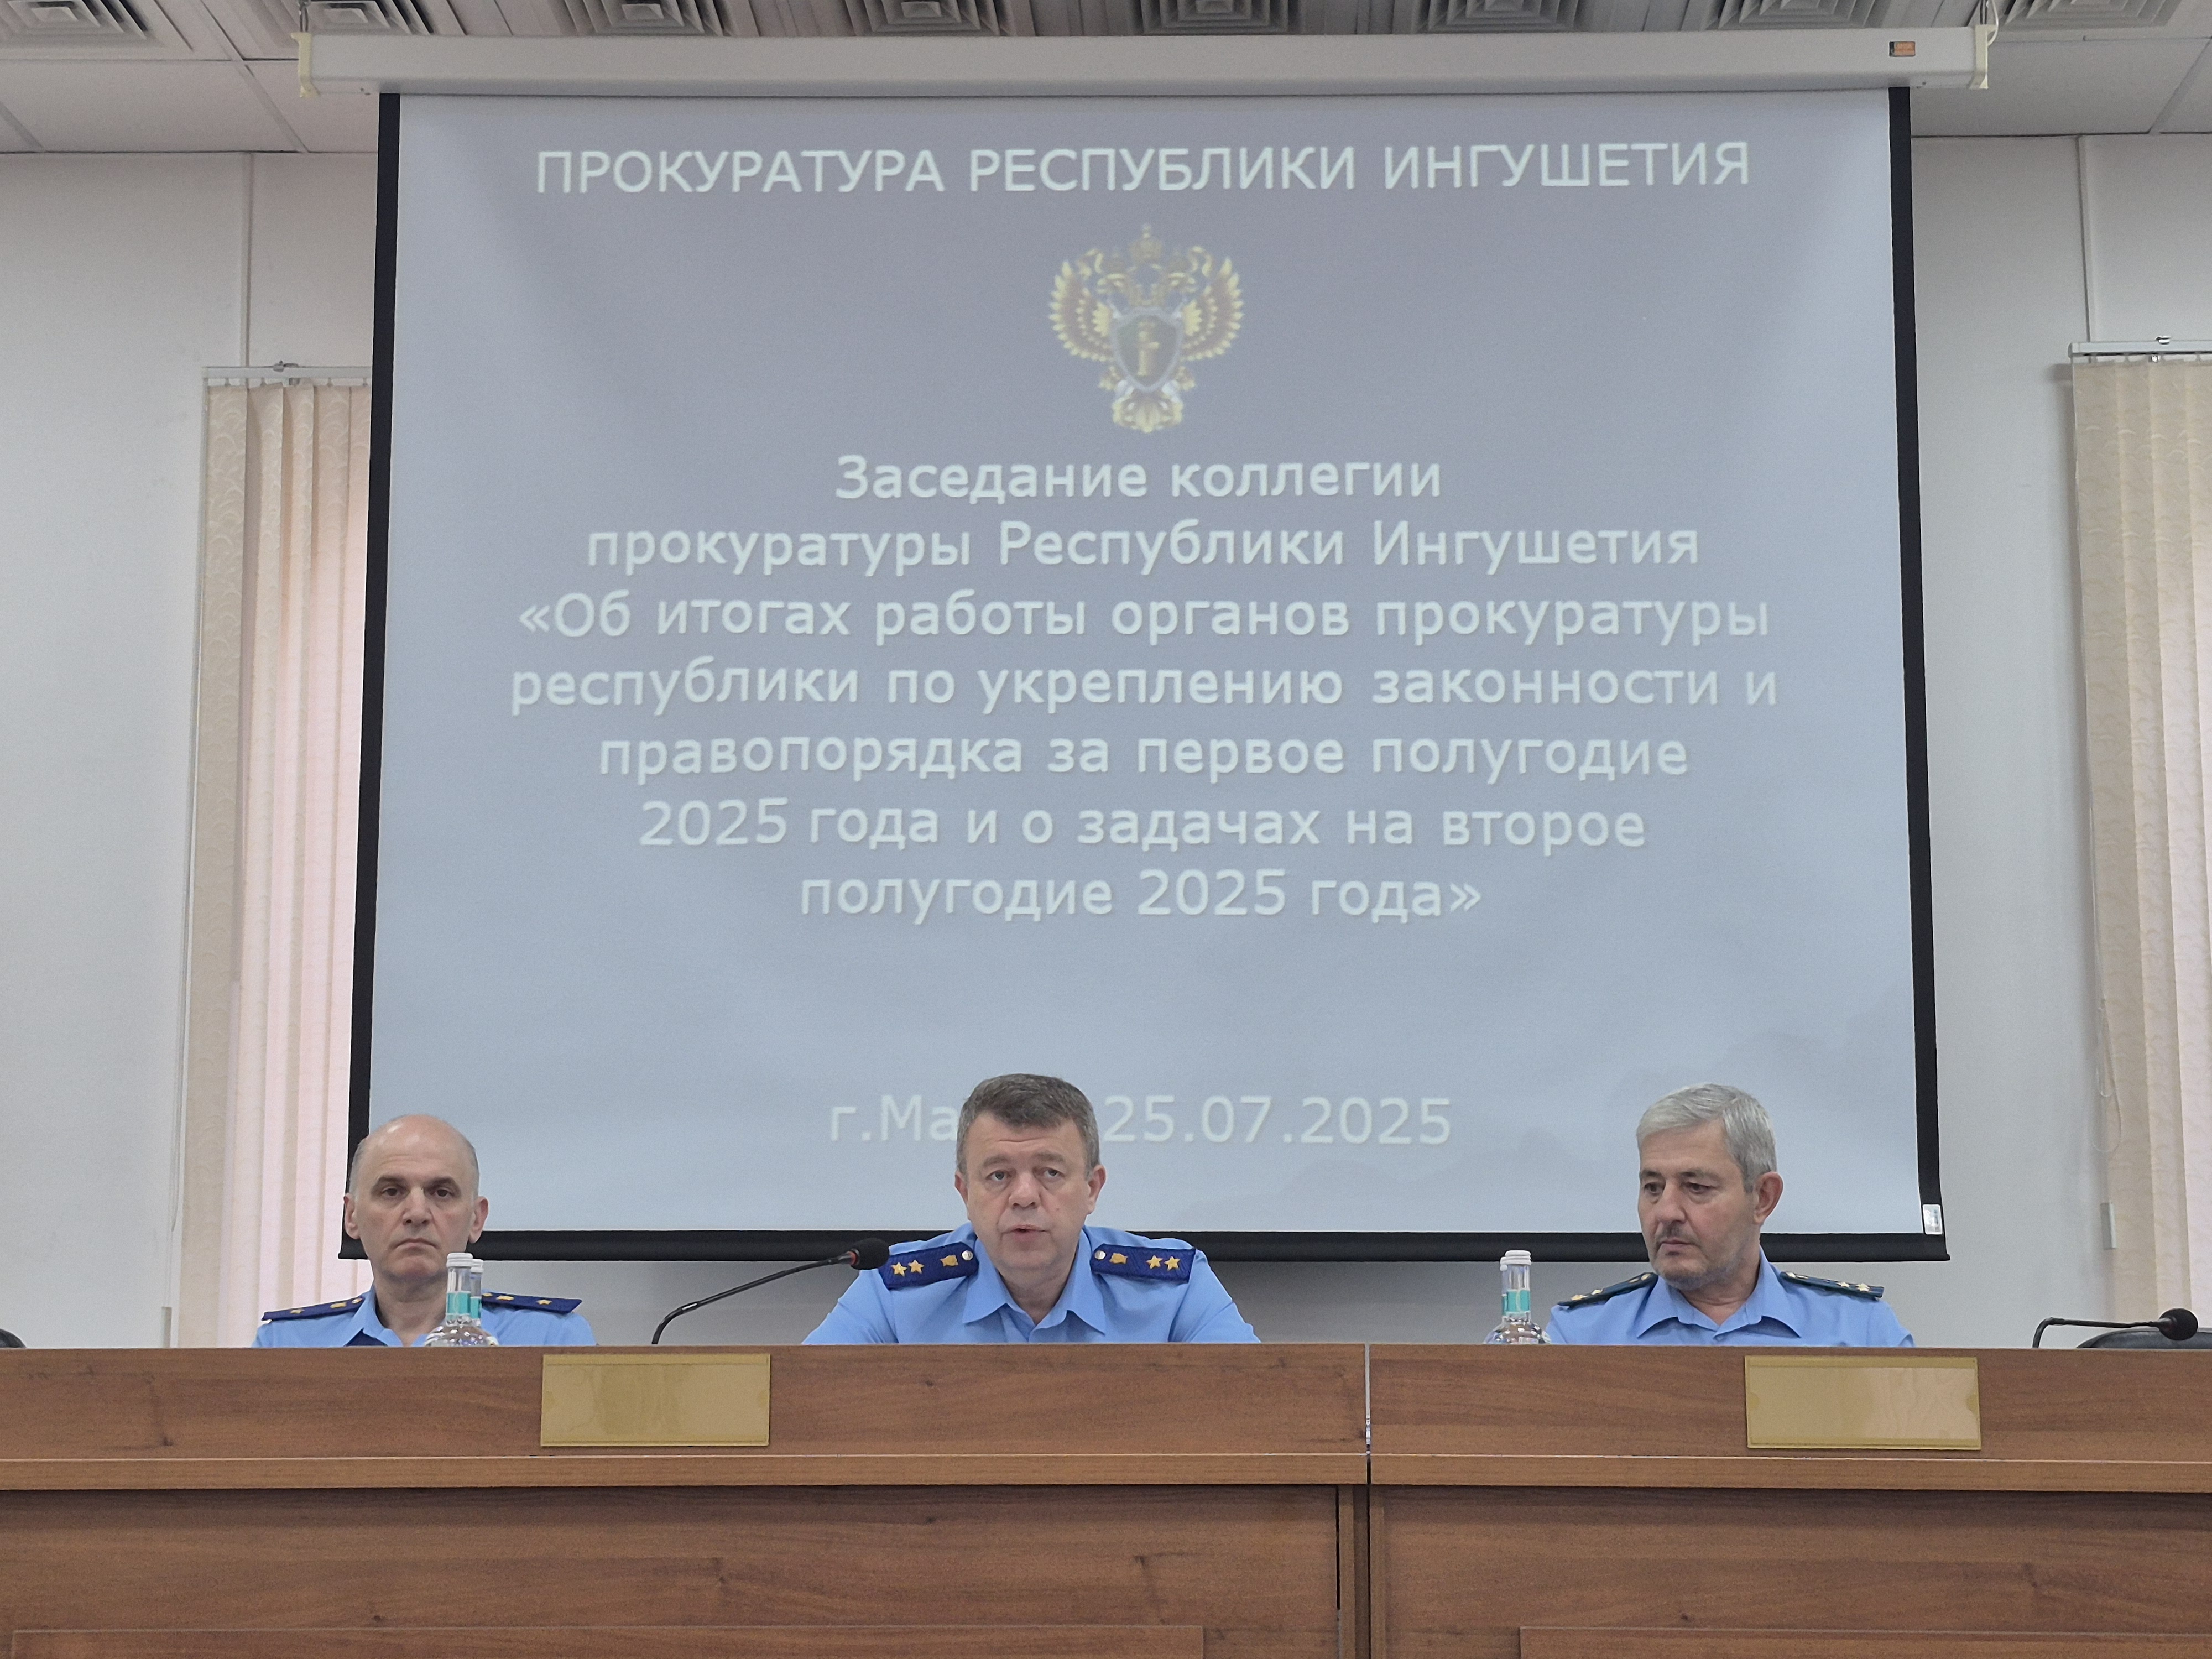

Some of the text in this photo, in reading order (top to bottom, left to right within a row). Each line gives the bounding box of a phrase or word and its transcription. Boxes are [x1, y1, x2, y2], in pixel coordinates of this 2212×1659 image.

[536, 140, 1751, 194] ПРОКУРАТУРА РЕСПУБЛИКИ ИНГУШЕТИЯ
[835, 453, 1441, 505] Заседание коллегии
[588, 517, 1699, 577] прокуратуры Республики Ингушетия
[519, 588, 1769, 648] «Об итогах работы органов прокуратуры
[510, 655, 1777, 716] республики по укреплению законности и
[599, 735, 1689, 786] правопорядка за первое полугодие
[639, 797, 1646, 858] 2025 года и о задачах на второе
[800, 868, 1481, 925] полугодие 2025 года»
[831, 1094, 1451, 1144] г.Ма 25.07.2025
